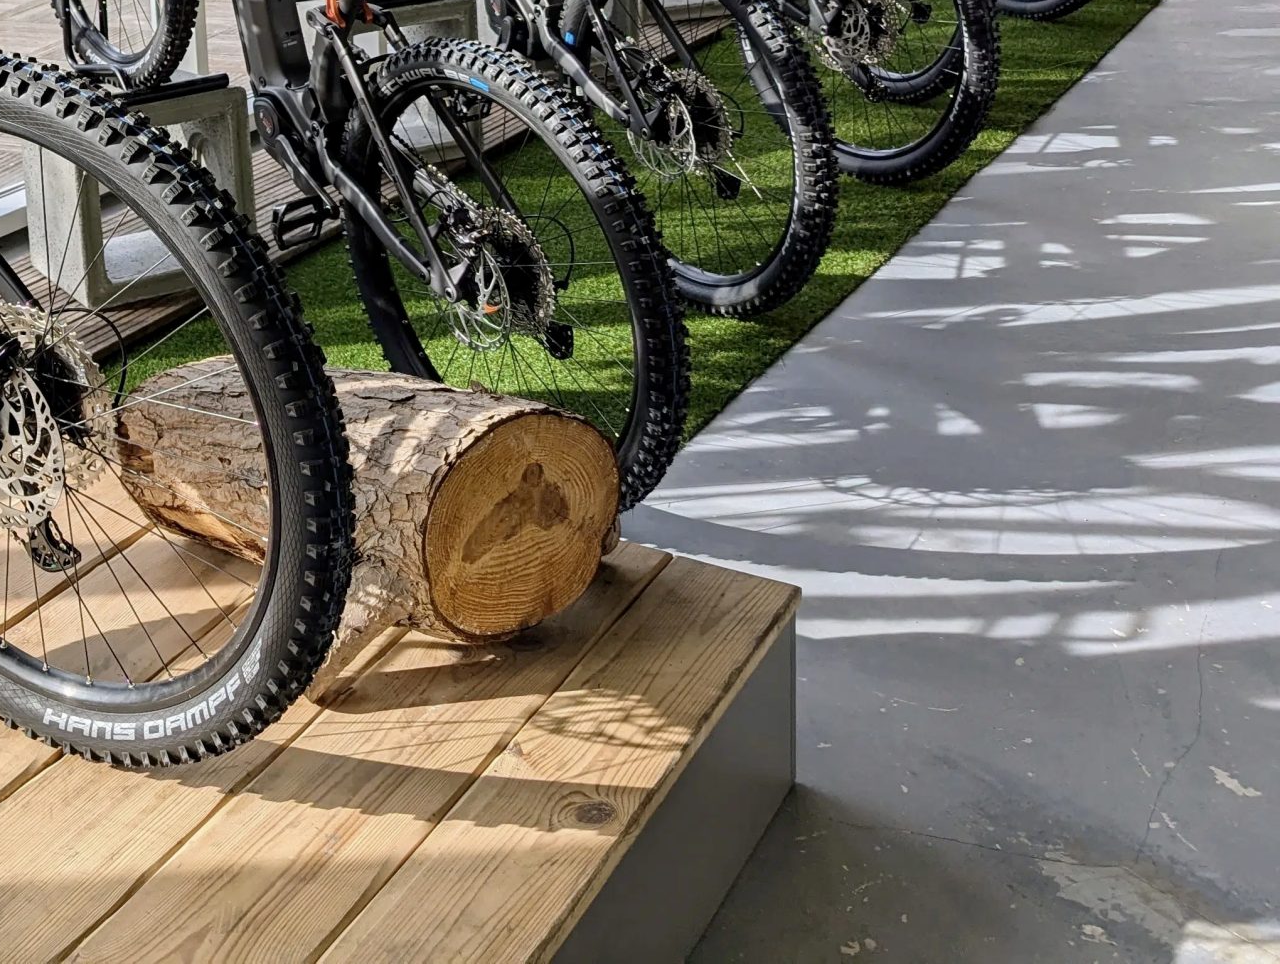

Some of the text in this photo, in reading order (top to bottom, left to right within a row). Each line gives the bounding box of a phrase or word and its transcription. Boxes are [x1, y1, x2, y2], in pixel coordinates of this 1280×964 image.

[380, 67, 471, 96] SCHWALBE
[42, 672, 242, 741] HANS DAMPF
